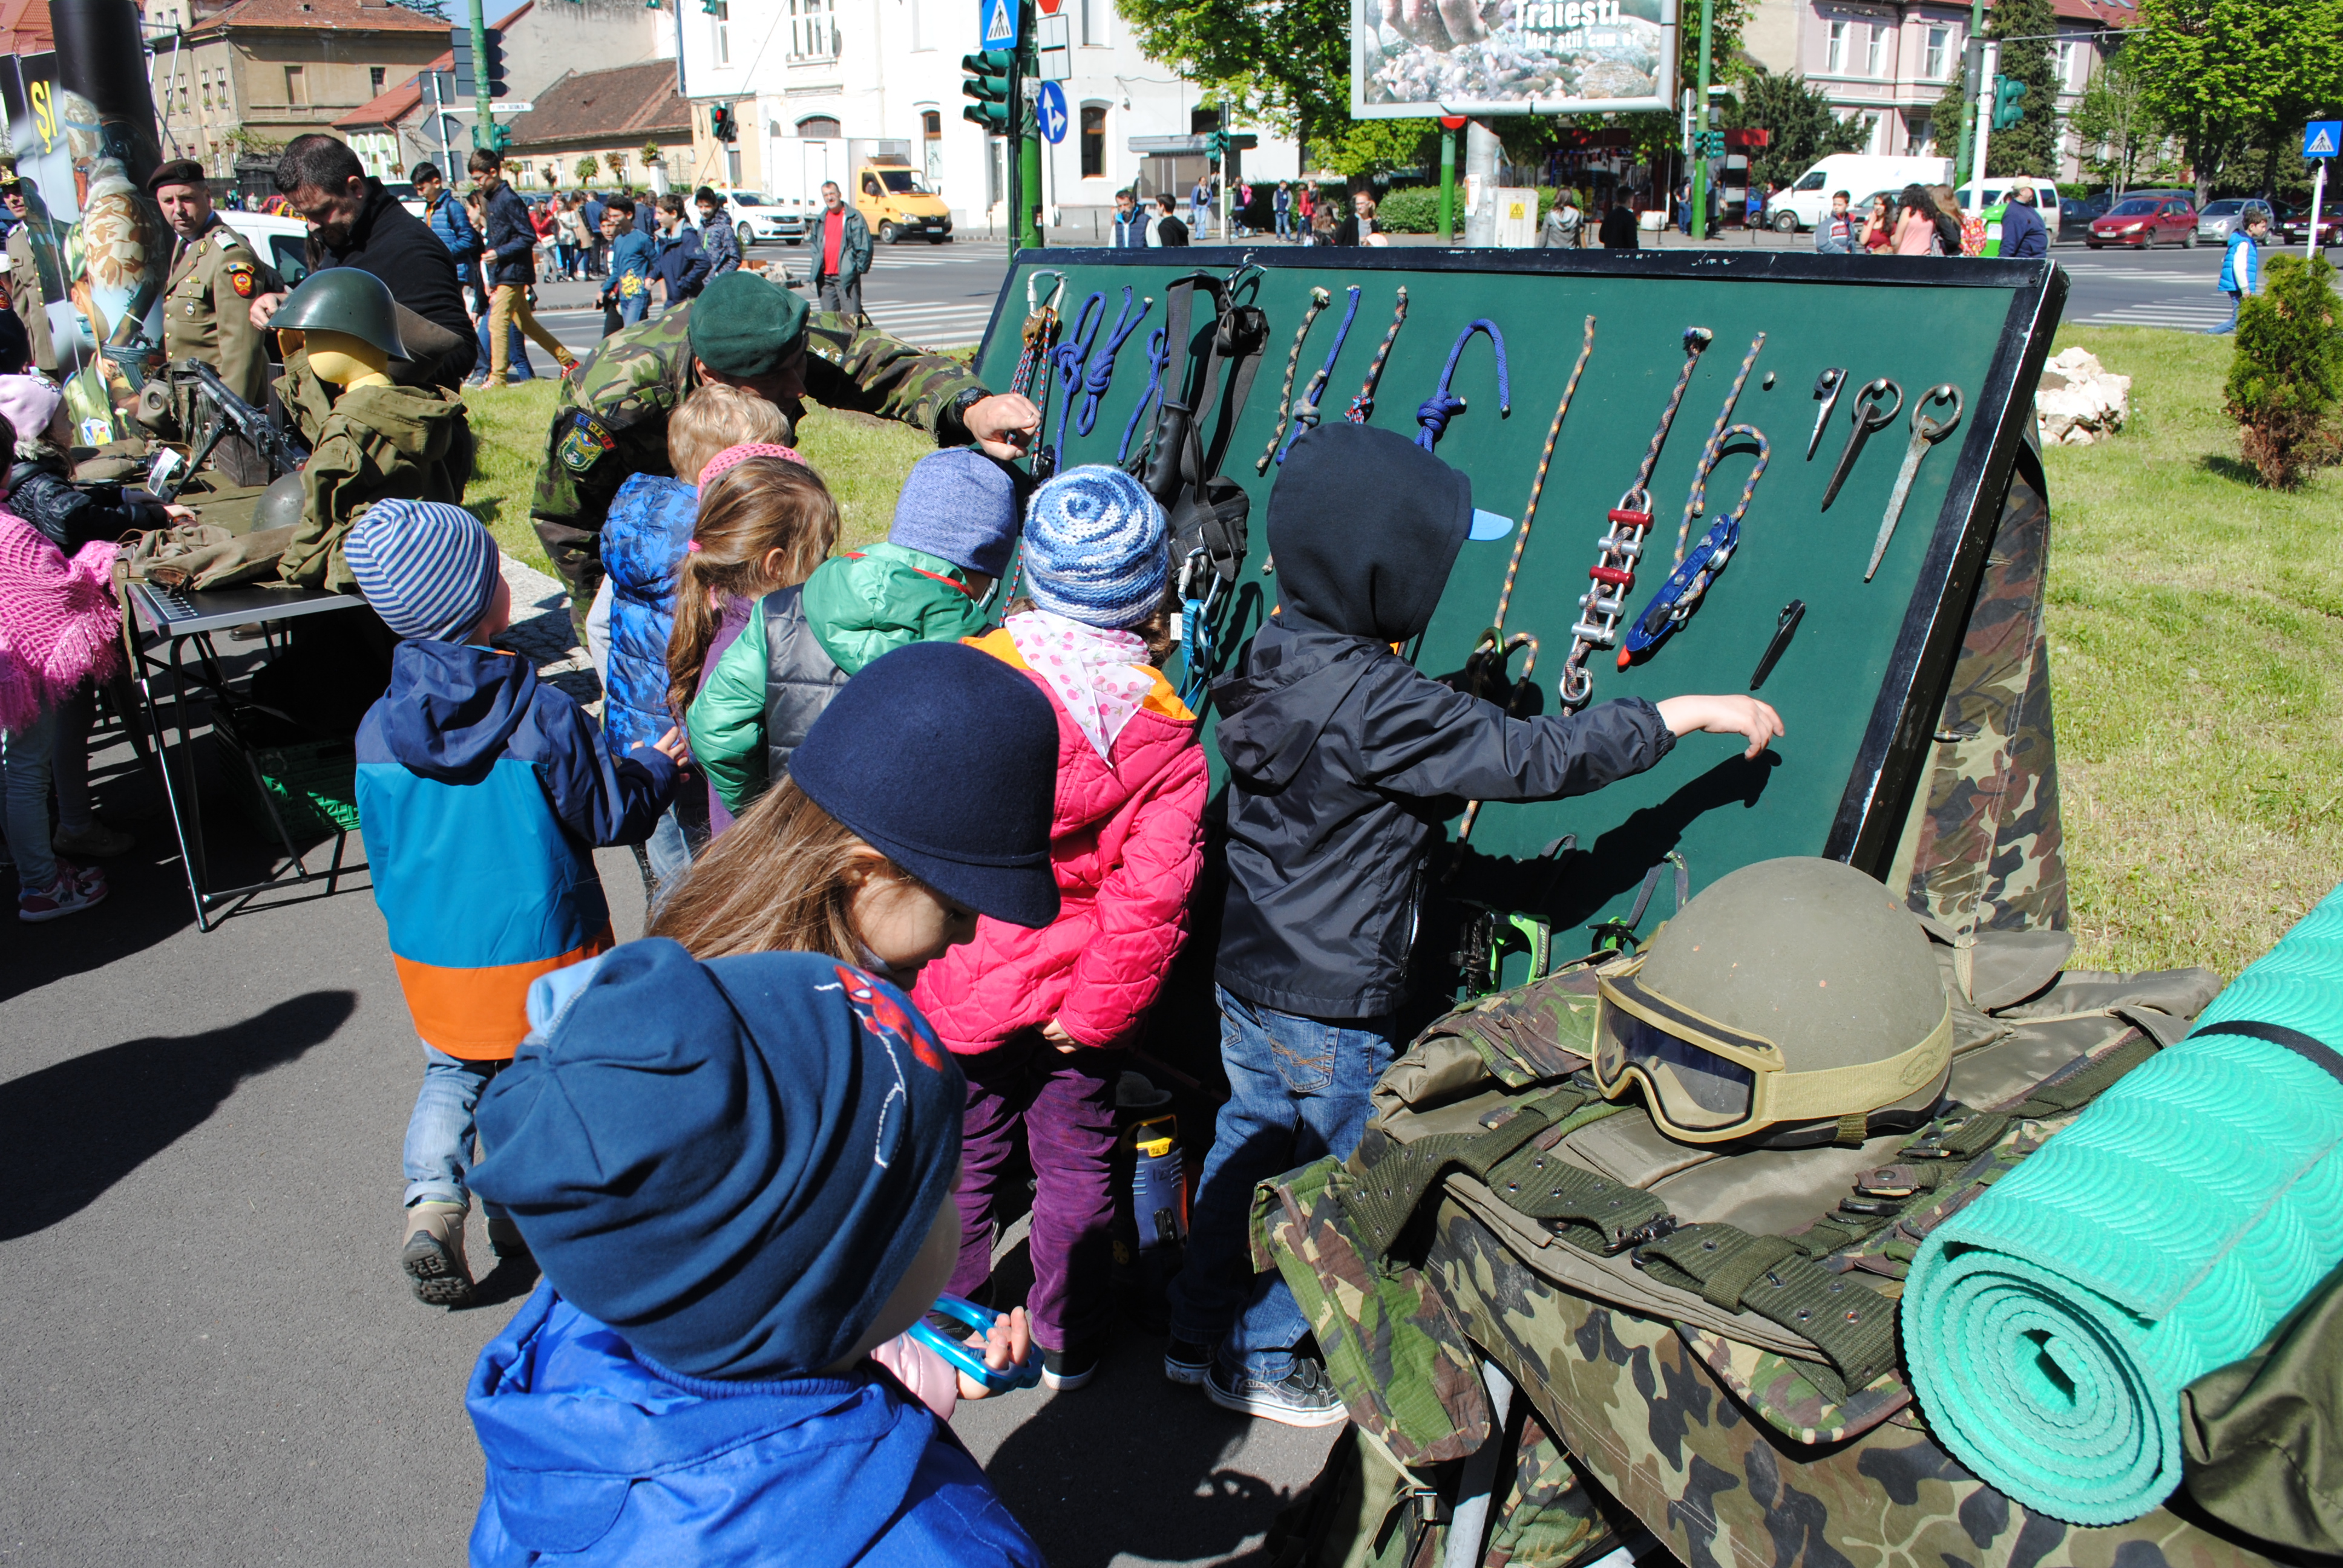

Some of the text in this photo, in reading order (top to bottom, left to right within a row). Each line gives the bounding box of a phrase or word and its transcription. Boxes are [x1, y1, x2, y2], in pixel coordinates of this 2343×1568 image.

[1525, 31, 1551, 50] Mai
[1587, 33, 1616, 48] cum
[1622, 28, 1639, 47] e?
